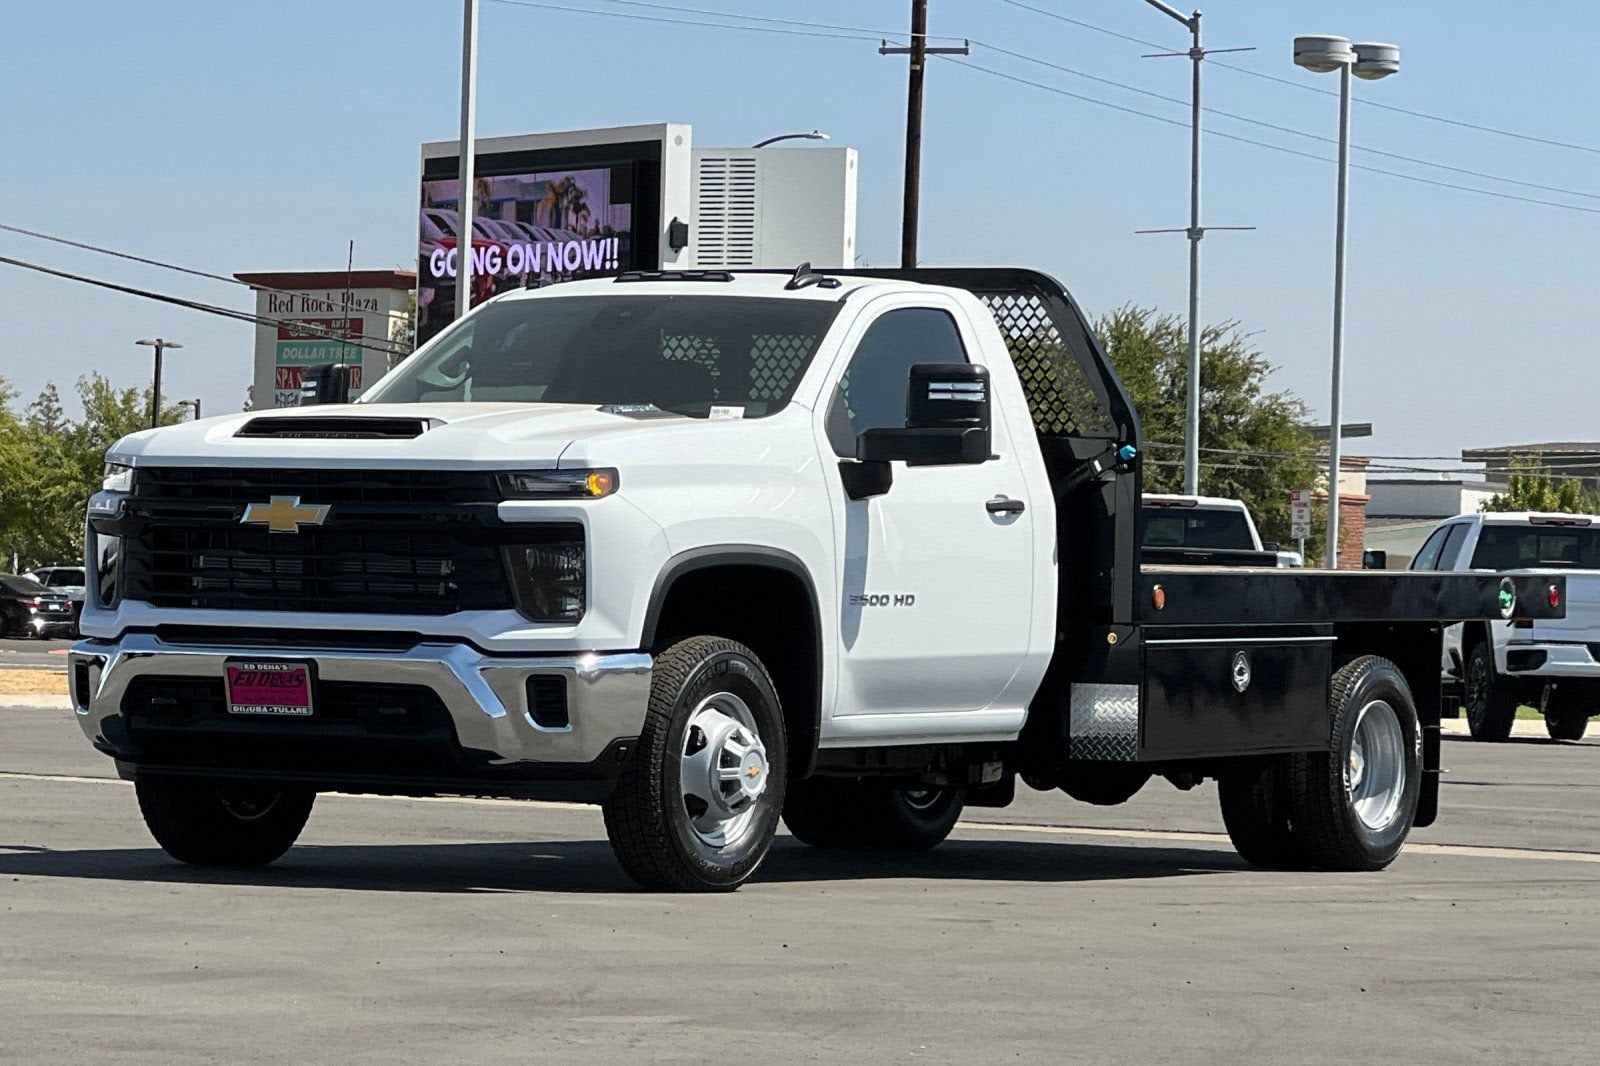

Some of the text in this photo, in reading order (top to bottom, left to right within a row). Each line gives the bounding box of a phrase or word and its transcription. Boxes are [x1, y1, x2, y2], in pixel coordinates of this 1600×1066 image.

[430, 237, 619, 278] GONG ON NOW!!
[268, 292, 378, 313] Red Rock Plaza
[283, 347, 358, 359] DOLLAR TREE
[894, 594, 915, 606] HD
[272, 706, 308, 714] TULARE
